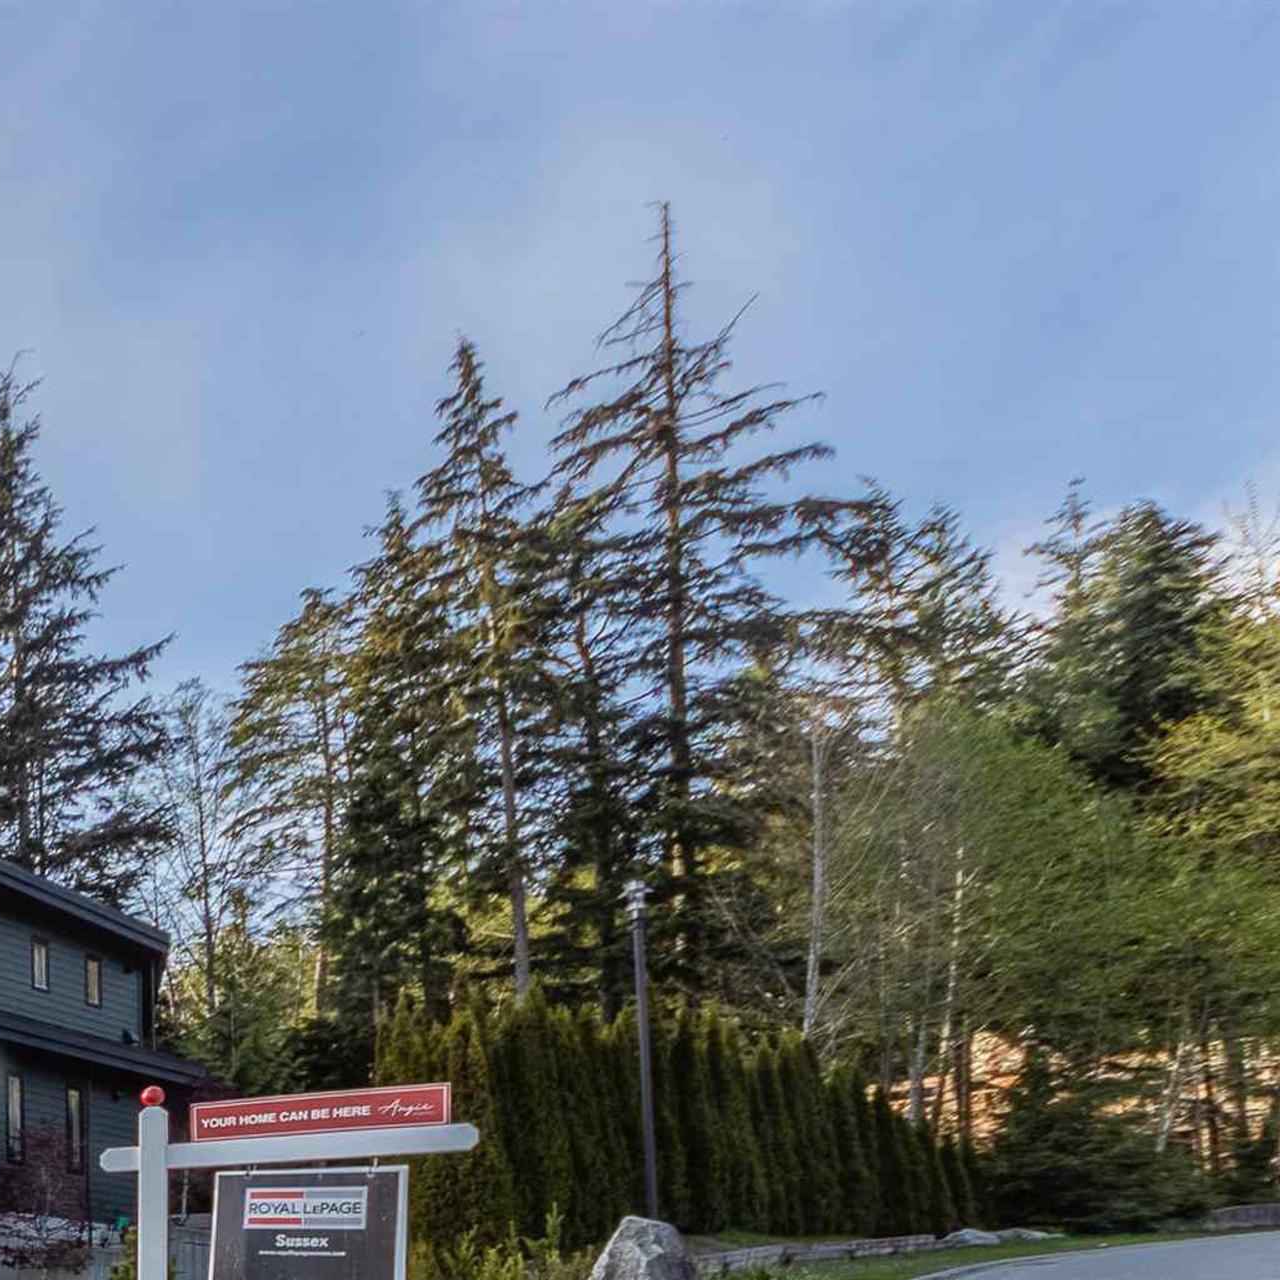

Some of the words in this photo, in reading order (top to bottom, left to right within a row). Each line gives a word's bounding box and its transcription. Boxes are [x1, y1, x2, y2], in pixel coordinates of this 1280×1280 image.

[201, 1116, 237, 1129] YOUR
[239, 1113, 276, 1125] HOME
[279, 1111, 309, 1122] CAN
[311, 1109, 331, 1121] BE
[333, 1105, 371, 1117] HERE
[249, 1202, 300, 1214] ROYAL
[275, 1234, 329, 1247] Sussex
